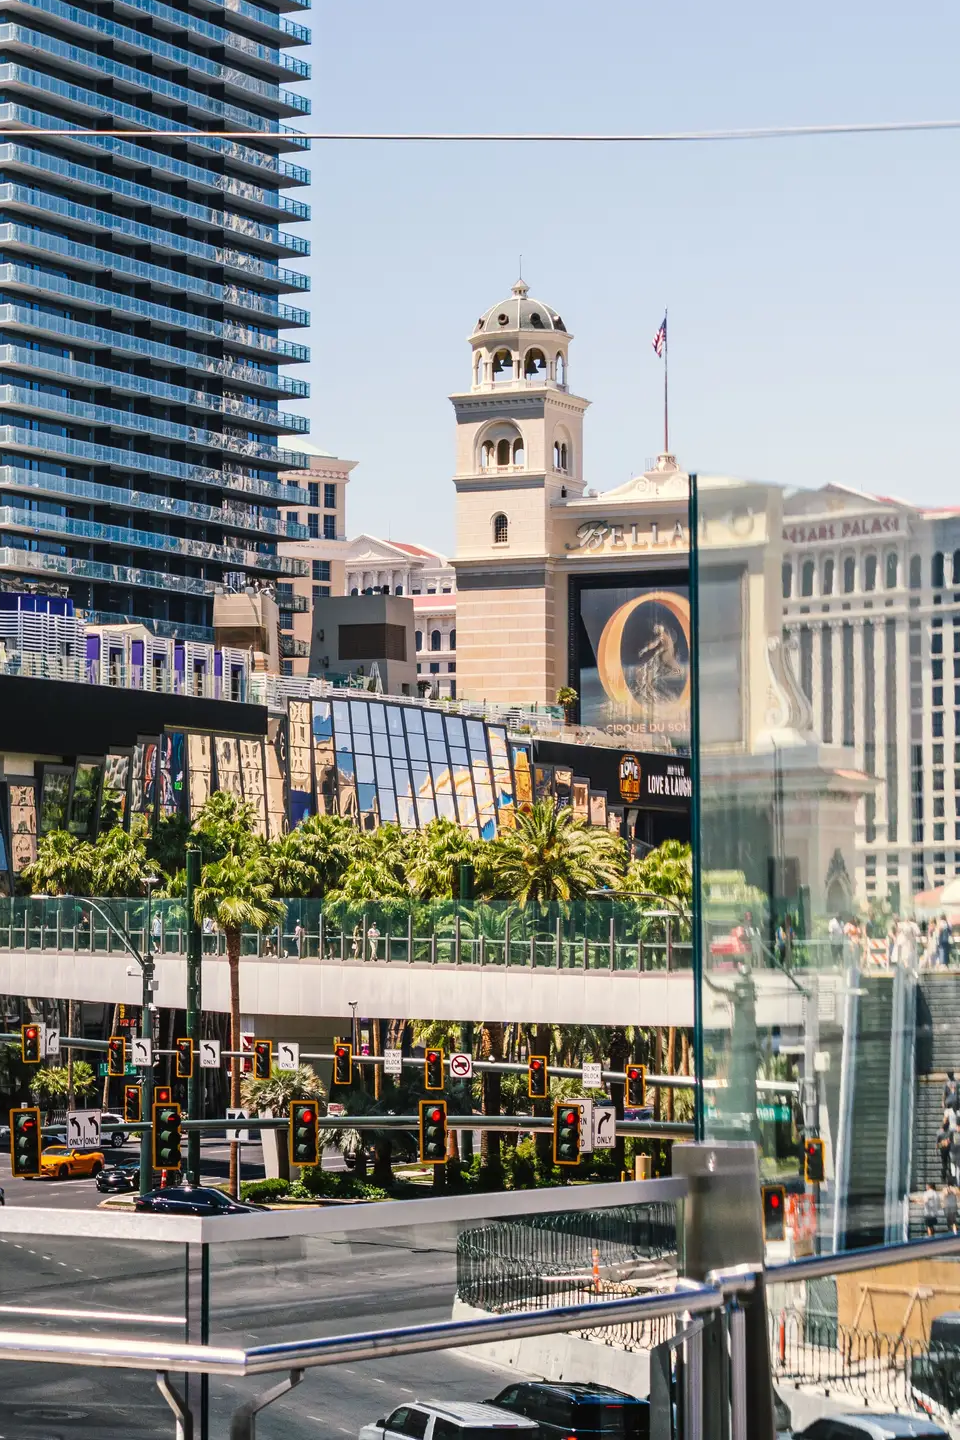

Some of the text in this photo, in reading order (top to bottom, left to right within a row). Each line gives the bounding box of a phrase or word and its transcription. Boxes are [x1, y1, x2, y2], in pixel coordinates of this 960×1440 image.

[606, 721, 690, 733] CIRQUE DU SOL
[648, 774, 664, 795] LOVE
[665, 775, 670, 796] &
[70, 1137, 99, 1146] ONLY ONLY
[596, 1136, 612, 1145] ONLY
